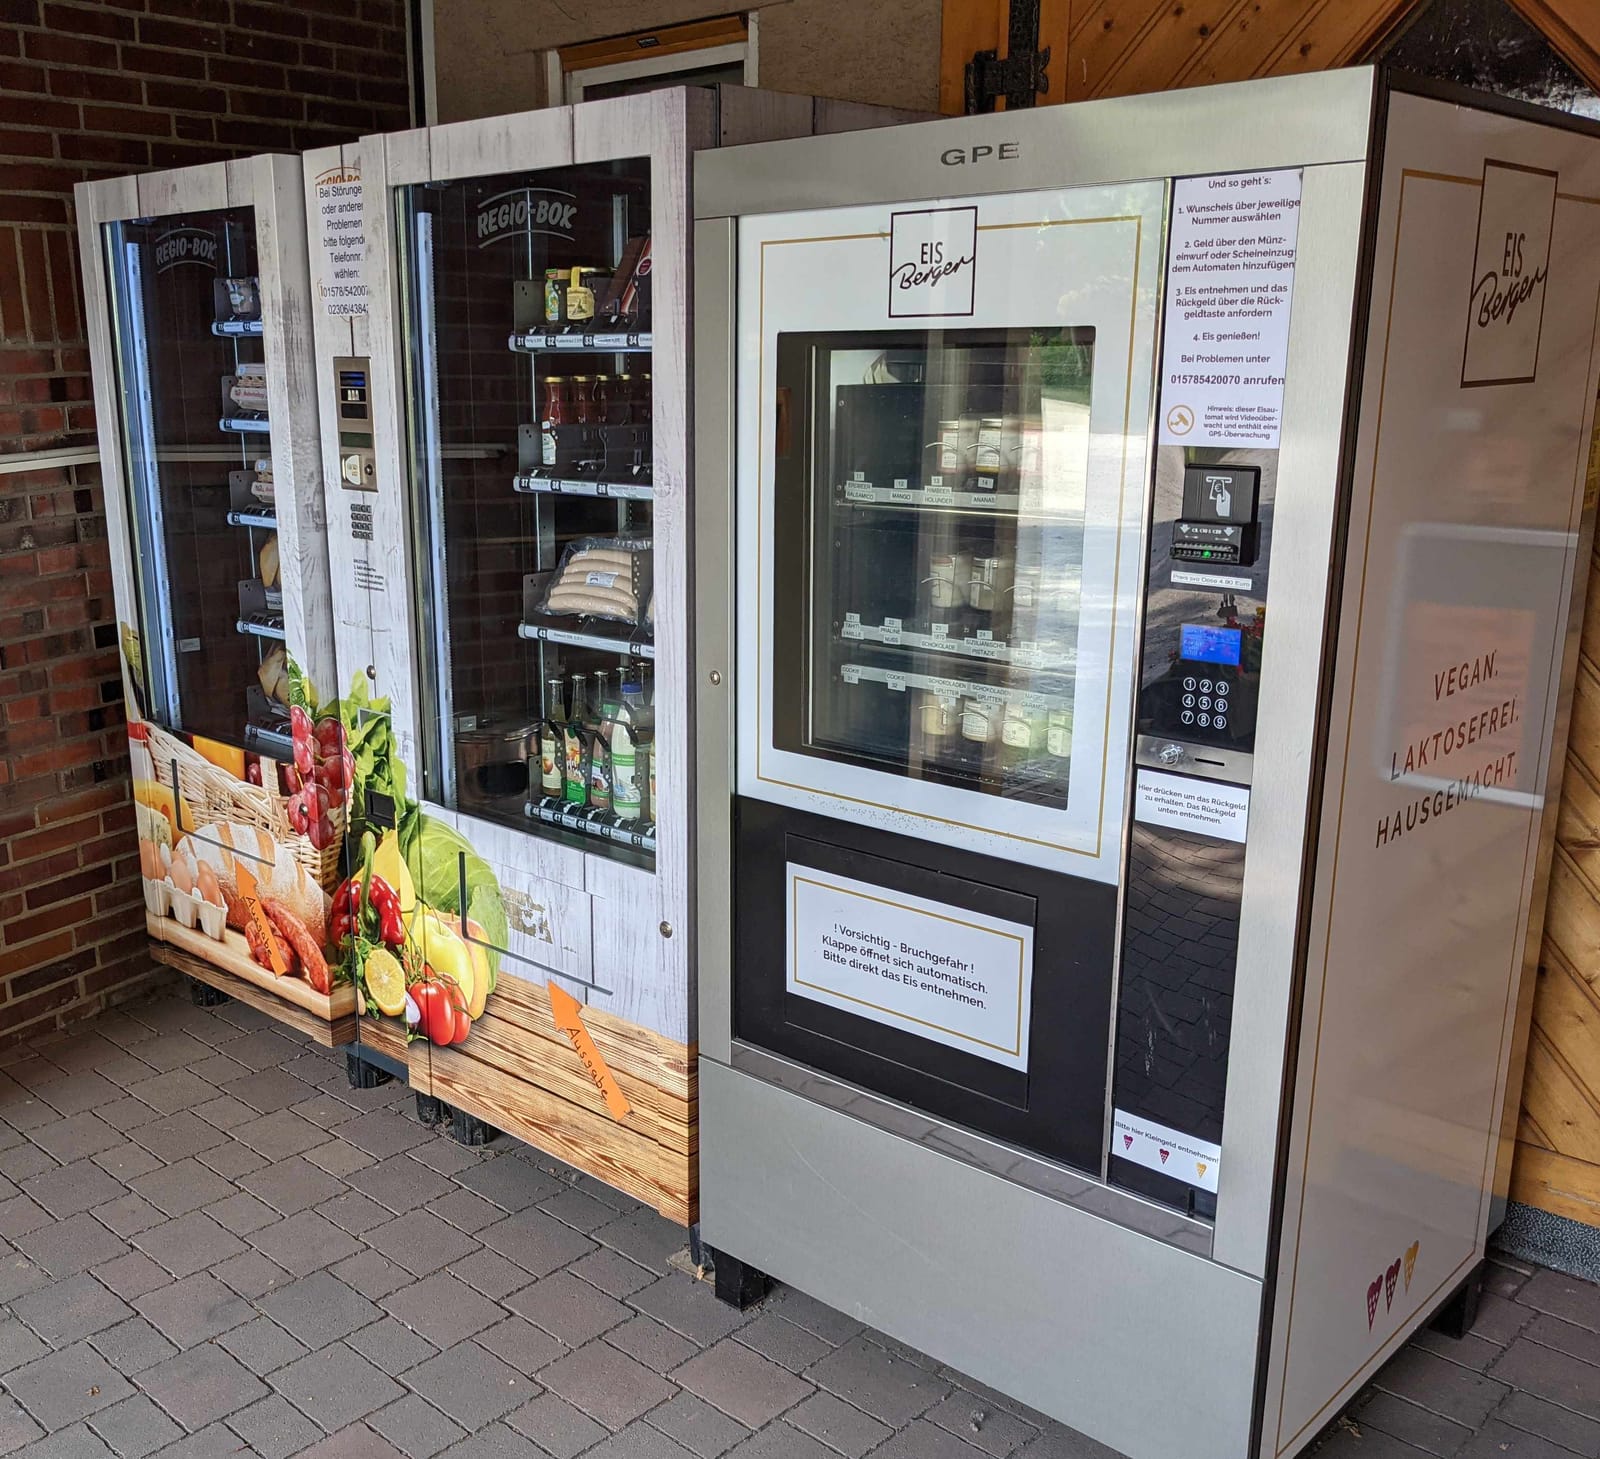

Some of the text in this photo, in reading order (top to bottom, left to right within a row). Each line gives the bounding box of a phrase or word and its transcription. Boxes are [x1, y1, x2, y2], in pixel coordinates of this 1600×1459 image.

[940, 141, 1020, 166] GPE
[1208, 179, 1226, 189] Und
[1228, 180, 1239, 188] so
[319, 187, 330, 199] Bei
[322, 204, 336, 215] oder
[1186, 202, 1233, 214] Wunscheis
[1235, 200, 1257, 211] über
[1257, 197, 1301, 211] jeweilige
[326, 218, 362, 231] Problemen
[477, 199, 577, 239] REGIO-BOX
[1191, 212, 1281, 225] Nummer auswählen
[323, 236, 337, 248] bitte
[1184, 235, 1287, 249] 2. Geld über den Münz-
[155, 237, 217, 266] REGIO-BOX
[329, 251, 364, 263] Telefonnr.
[920, 241, 943, 265] EIS
[1176, 247, 1294, 261] einwurf oder Scheineinzug
[1502, 232, 1527, 278] EIS
[890, 255, 975, 290] Berger
[1172, 259, 1295, 273] dem Automaten hinzufügen
[334, 268, 360, 280] wählen:
[1176, 283, 1288, 296] 3. Eis entnehmen und das
[1176, 295, 1284, 308] Rückgeld über die Rück-
[1471, 266, 1548, 328] Berger
[1184, 308, 1273, 320] geldtaste anfordern
[547, 336, 555, 346] 32
[584, 336, 593, 346] 33
[629, 335, 638, 345] 34
[1193, 331, 1261, 342] 4. Eis genießen!
[1181, 354, 1271, 363] Bei Problemen unter
[1170, 374, 1286, 385] 015785420070 anrufen
[1207, 405, 1234, 413] Hinweis:
[1235, 405, 1256, 413] dieser
[1240, 413, 1278, 422] Videoüber-
[1238, 422, 1262, 430] enthält
[1208, 430, 1271, 440] GPS-Überwachung
[973, 496, 996, 504] ANANAS
[631, 644, 640, 654] 44
[927, 676, 967, 690] SCHOKOLADEN
[1434, 651, 1498, 701] VEGAN.
[1390, 696, 1519, 781] LAKTOSEFREI.
[1138, 783, 1152, 792] Hier
[1153, 787, 1182, 798] drücken
[1196, 795, 1210, 804] das
[1211, 798, 1246, 811] Rückgeld
[1375, 751, 1518, 849] HAUSGEMACHT.
[1154, 796, 1185, 808] erhalten.
[1186, 802, 1200, 811] Das
[1201, 805, 1236, 818] Rückgeld
[1157, 806, 1222, 824] unten entnehmen.
[554, 813, 562, 822] 47
[577, 819, 585, 829] 48
[601, 826, 610, 836] 49
[633, 834, 642, 845] 51
[245, 896, 273, 956] Ausgabe
[839, 923, 891, 951] Vorsichtig
[900, 942, 969, 973] Bruchgefahr
[821, 934, 988, 995] Klappe öffnet sich automatisch.
[823, 949, 987, 1011] Bitte direkt das Eis entnehmen.
[566, 1026, 609, 1101] Ausgabe
[1115, 1120, 1219, 1163] Bitte hier Kleingeld entnehmen!
